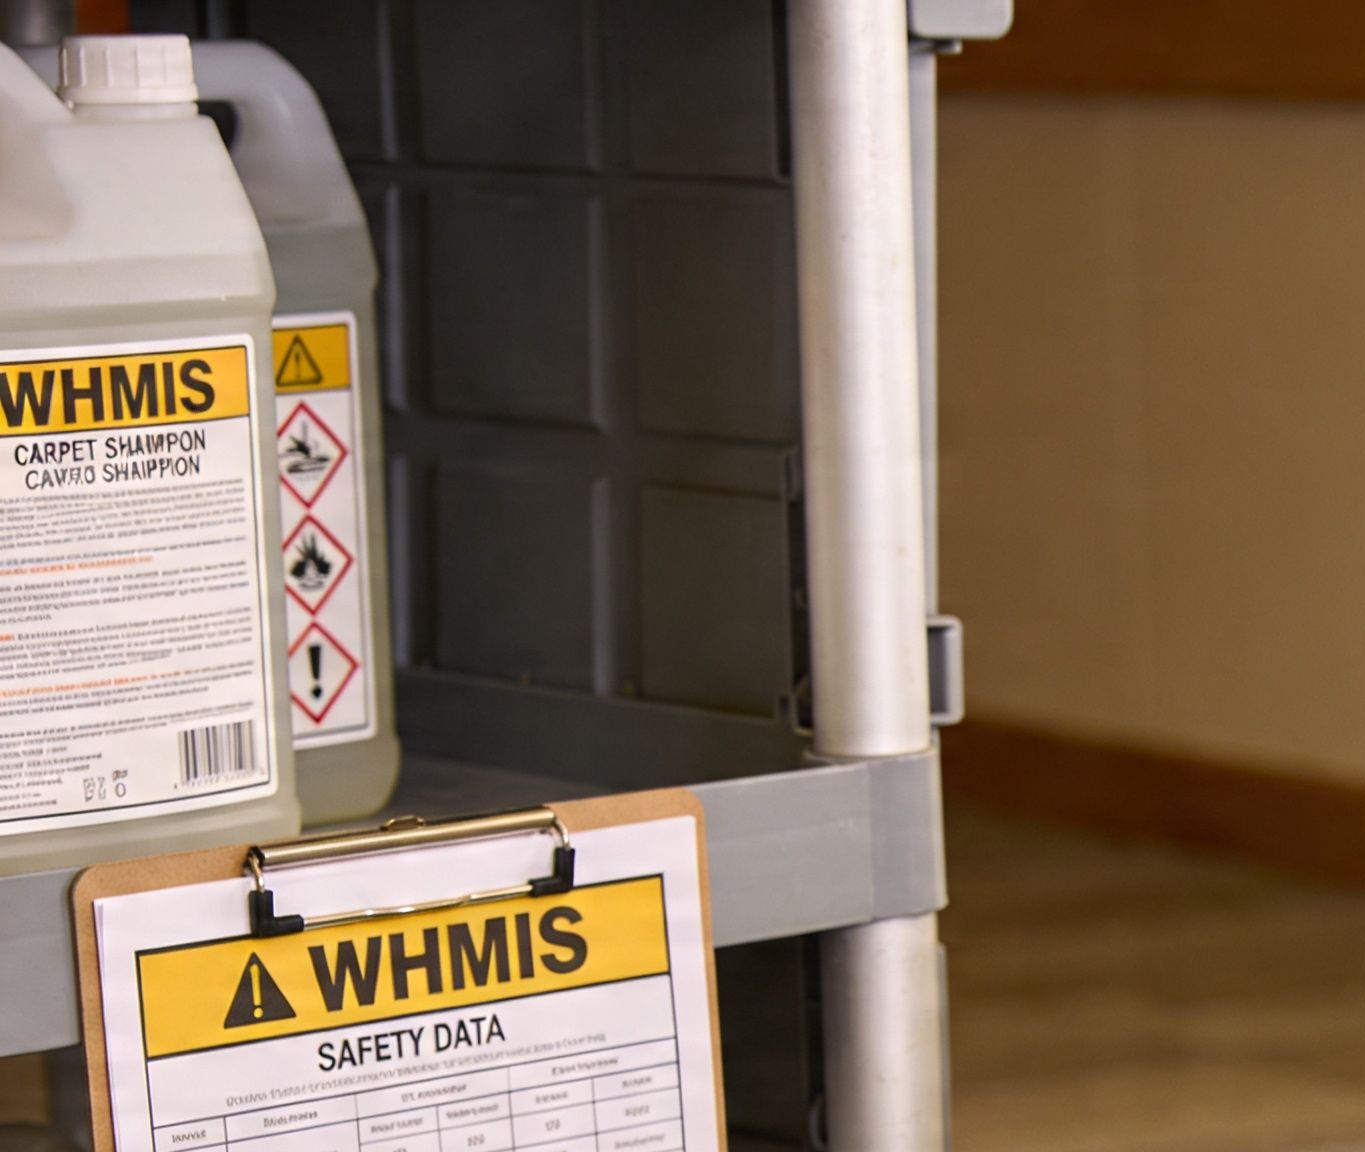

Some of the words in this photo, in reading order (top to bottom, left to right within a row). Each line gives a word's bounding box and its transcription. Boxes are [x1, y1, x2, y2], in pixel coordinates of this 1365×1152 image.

[0, 360, 216, 428] WHMIS
[14, 439, 97, 466] CARPET
[308, 906, 589, 1012] WHMIS
[317, 1025, 426, 1072] SAFETY
[434, 1013, 506, 1058] DATA
